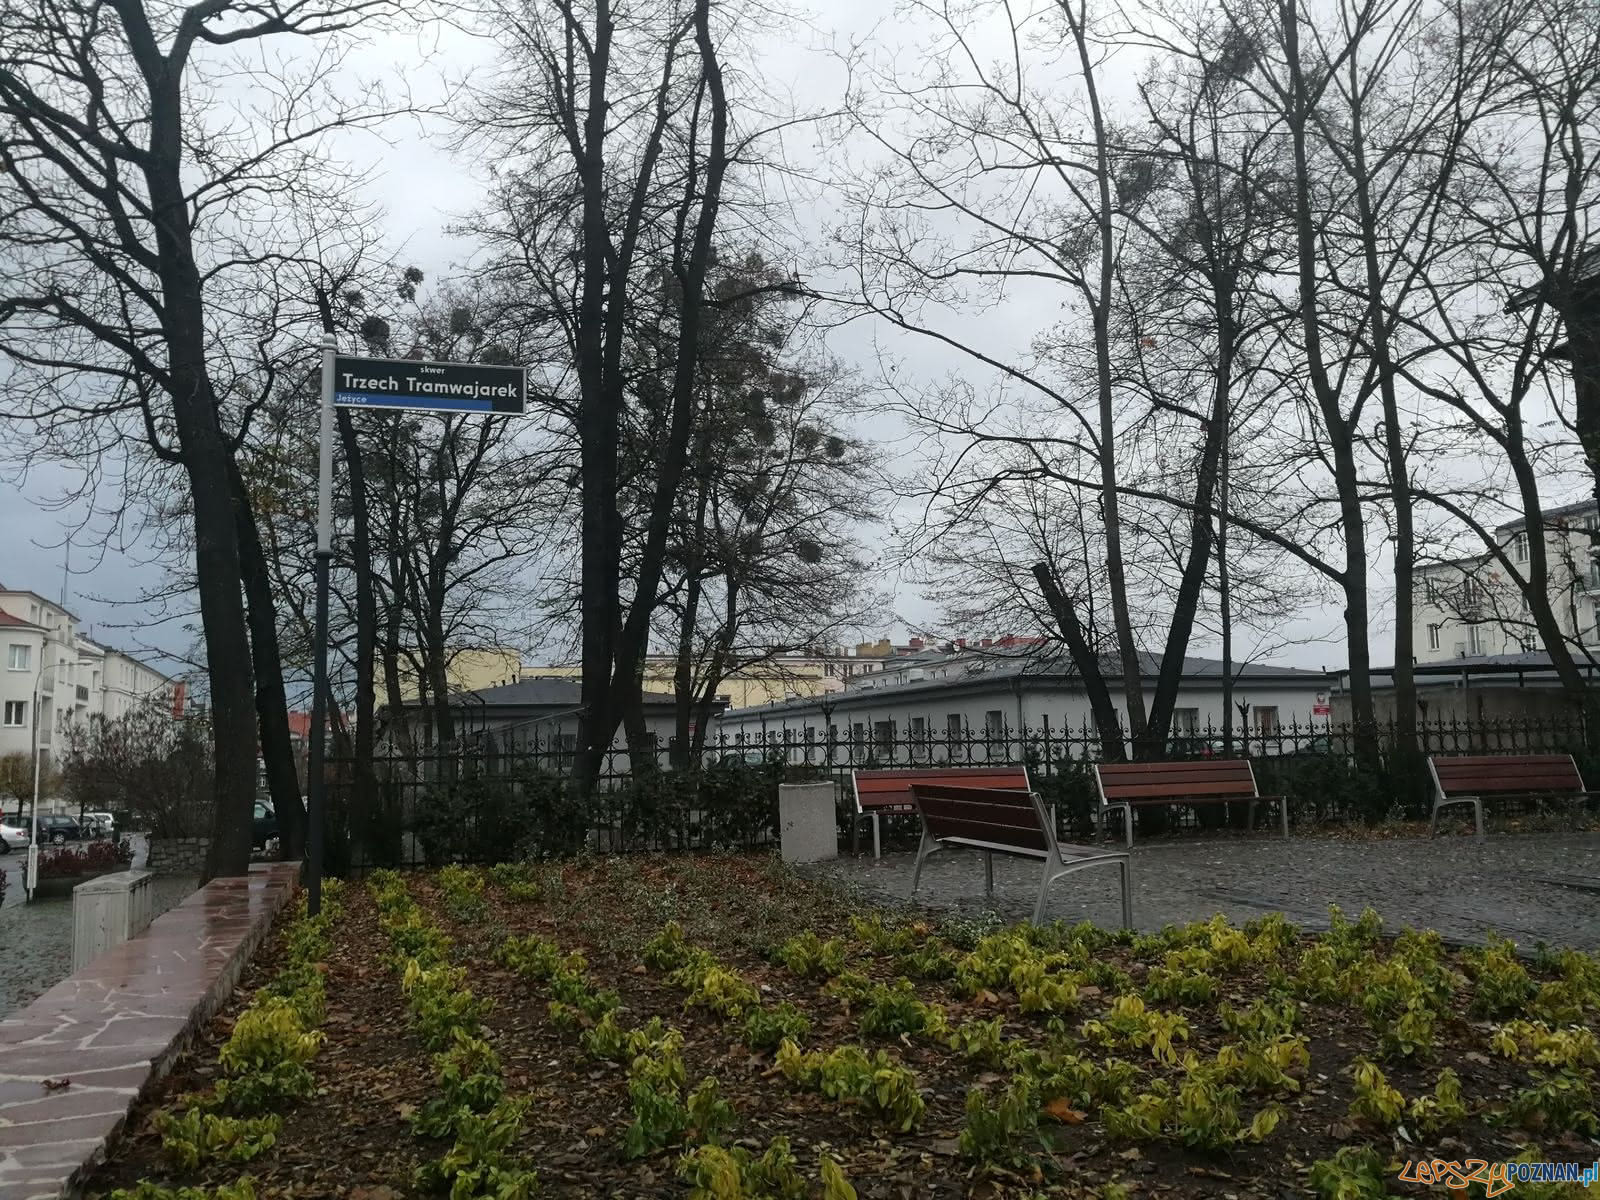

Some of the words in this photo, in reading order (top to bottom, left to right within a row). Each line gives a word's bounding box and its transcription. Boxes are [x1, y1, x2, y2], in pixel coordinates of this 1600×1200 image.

[420, 366, 446, 375] skwer
[343, 374, 399, 391] Trzech
[406, 377, 518, 398] Tramwajarek
[336, 394, 368, 404] Jeżyce
